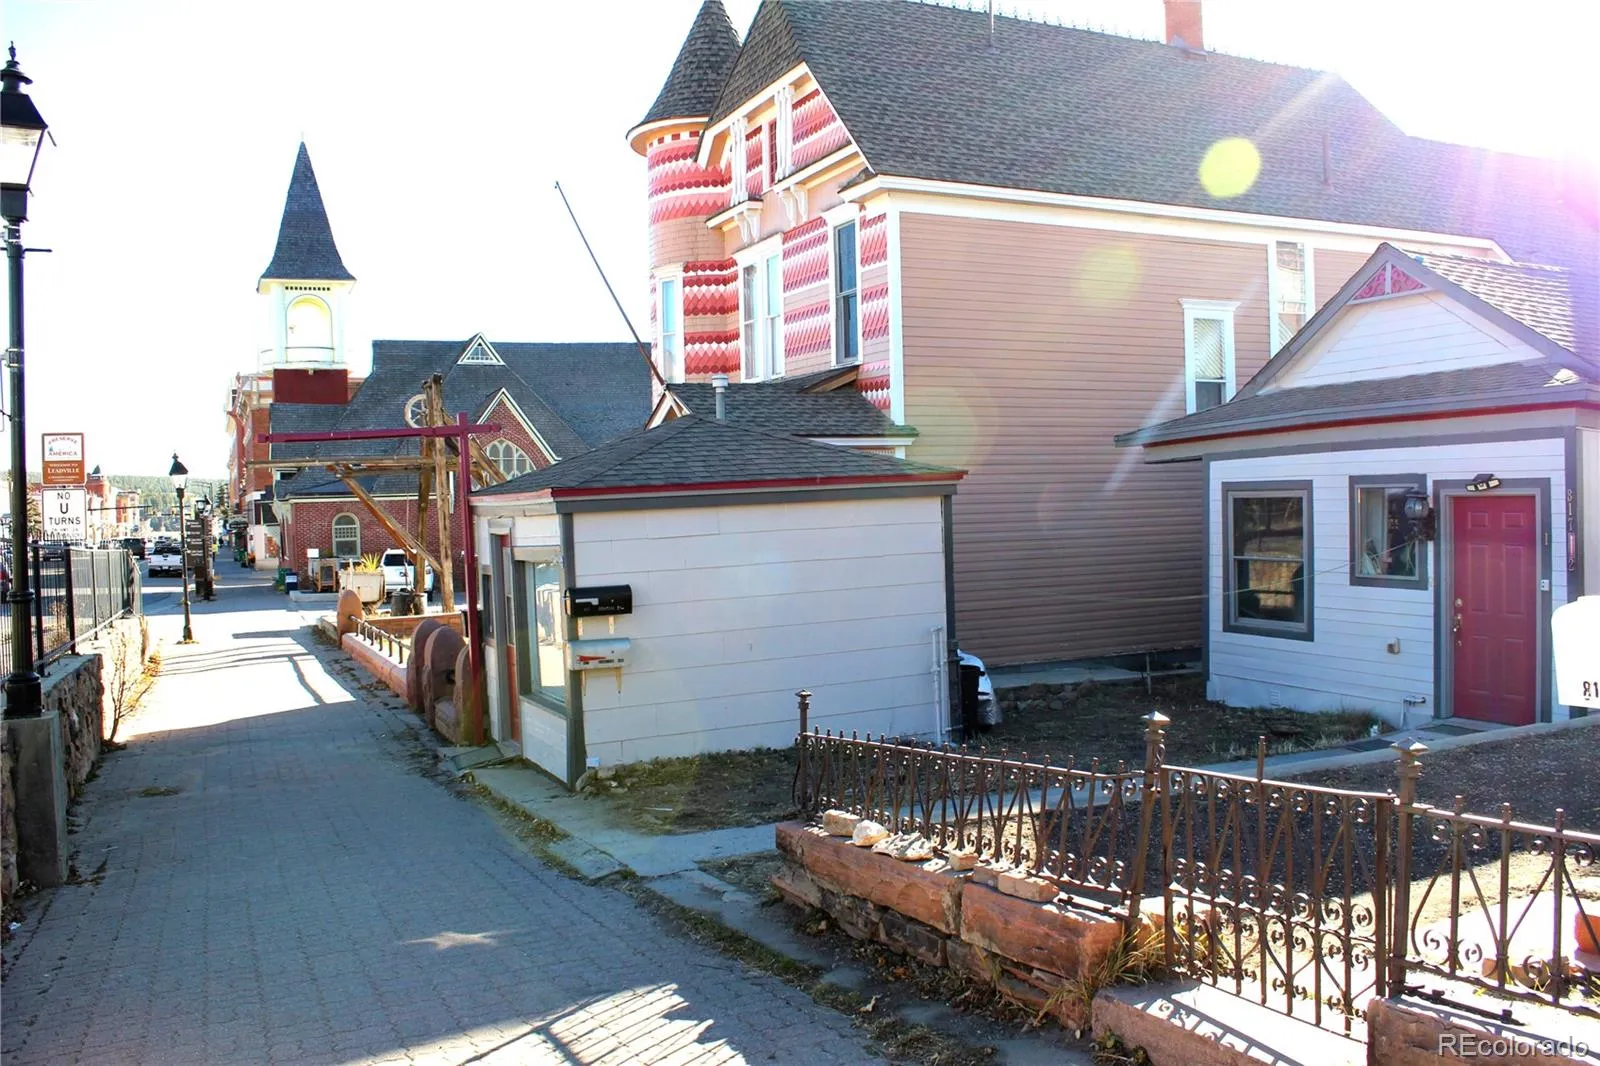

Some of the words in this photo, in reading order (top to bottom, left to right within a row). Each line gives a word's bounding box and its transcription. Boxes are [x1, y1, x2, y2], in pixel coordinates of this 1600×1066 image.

[57, 491, 71, 500] NO
[60, 503, 69, 514] U
[49, 516, 81, 526] TURNS
